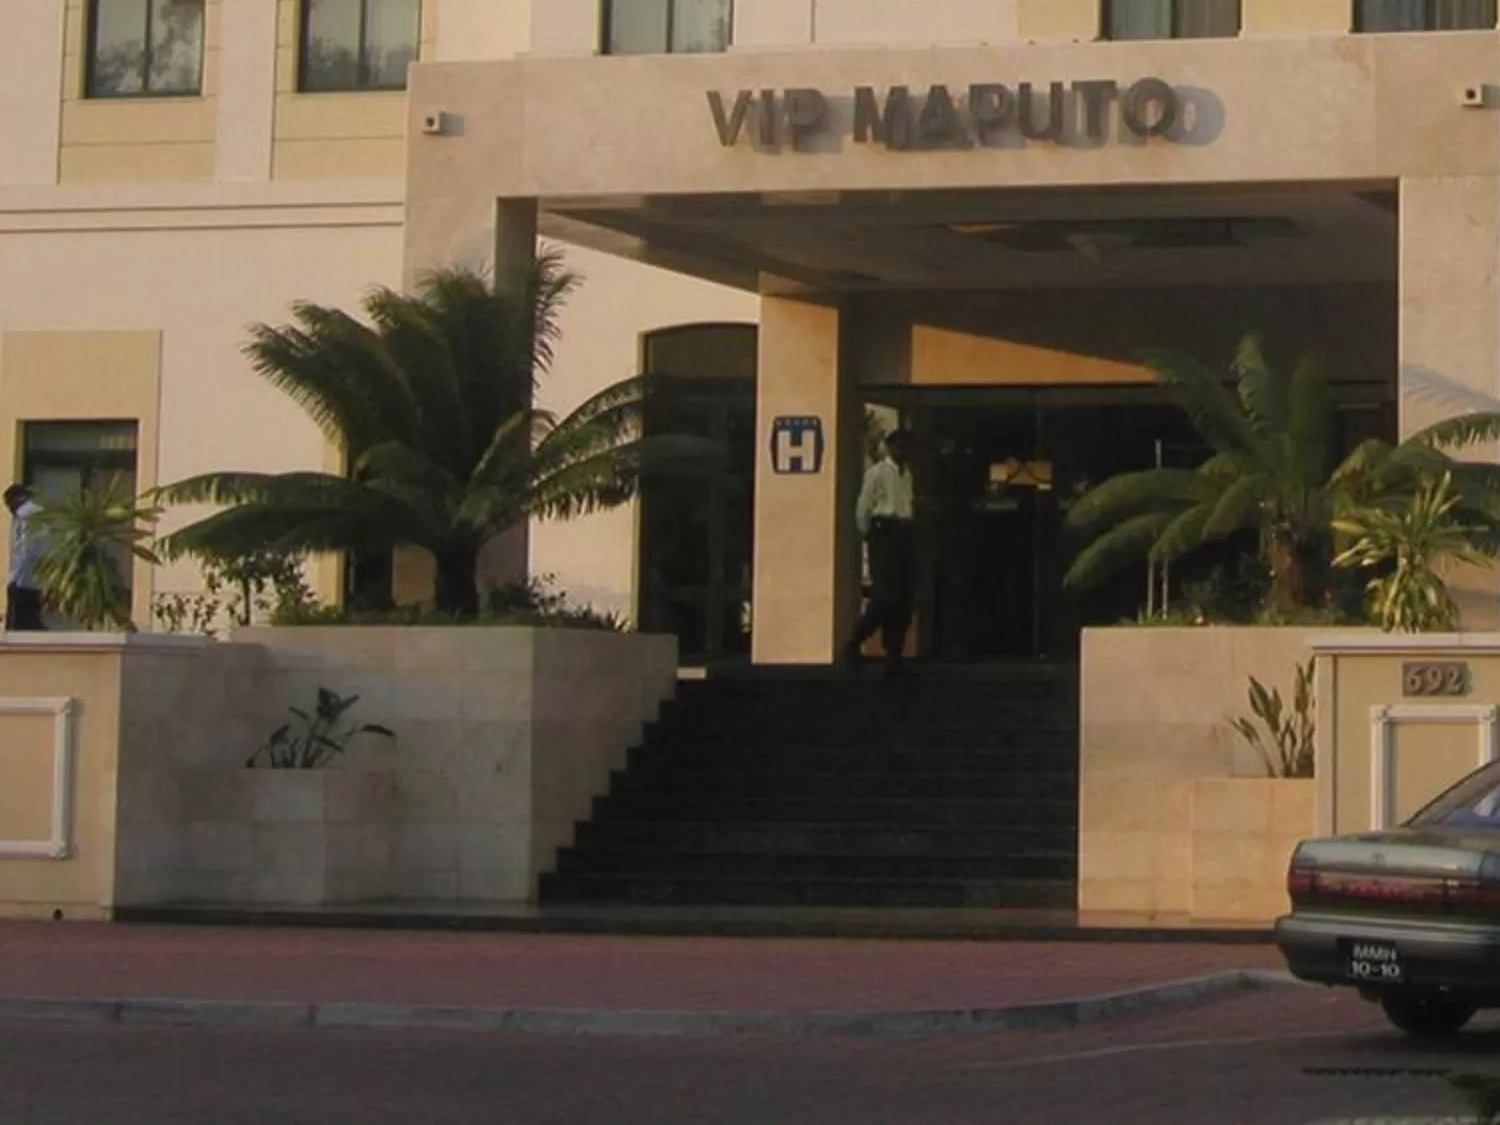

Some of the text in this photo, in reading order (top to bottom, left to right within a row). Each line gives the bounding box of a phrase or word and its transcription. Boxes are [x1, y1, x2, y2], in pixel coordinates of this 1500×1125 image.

[706, 76, 1180, 148] VIP MAPUTO
[1404, 665, 1465, 695] 692
[1351, 960, 1400, 977] 10-10
